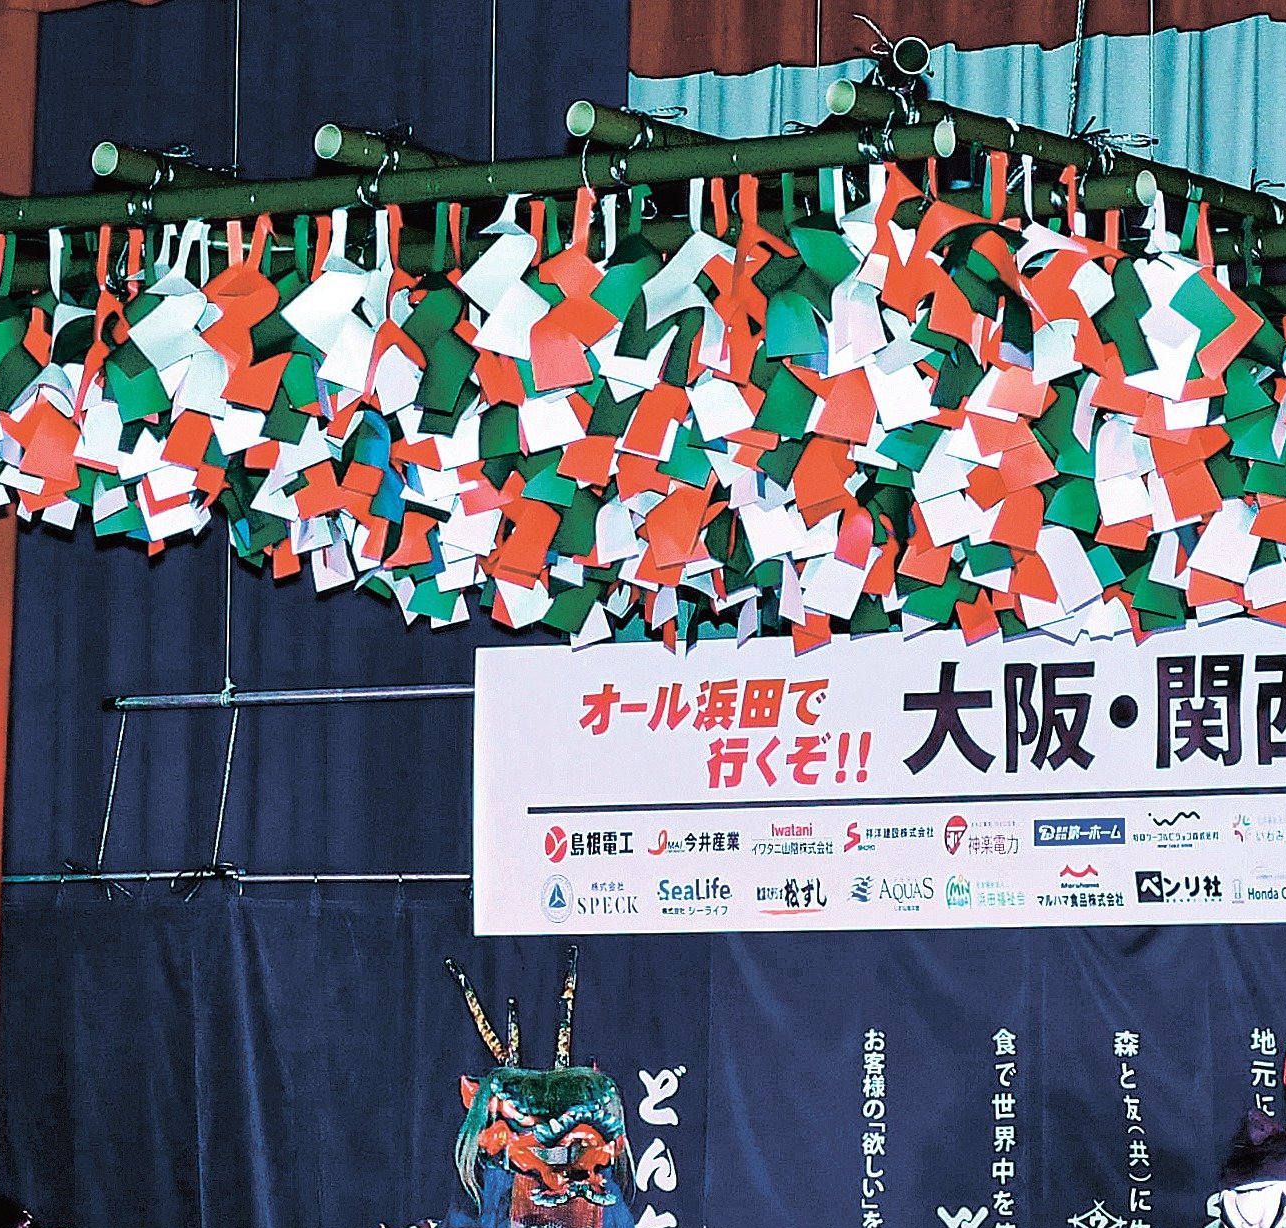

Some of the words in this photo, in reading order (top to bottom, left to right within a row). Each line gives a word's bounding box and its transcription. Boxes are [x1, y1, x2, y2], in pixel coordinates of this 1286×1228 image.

[578, 678, 830, 736] オール浜田で
[771, 822, 813, 837] Iwatani
[570, 831, 634, 856] 島根電工
[684, 832, 740, 852] 今井産業
[968, 834, 1019, 855] 神楽電力
[658, 877, 732, 901] SeaLife
[1248, 887, 1279, 901] Honda
[577, 895, 640, 915] SPECK
[688, 905, 728, 916] シーライフ
[1250, 1028, 1277, 1118] 地元に
